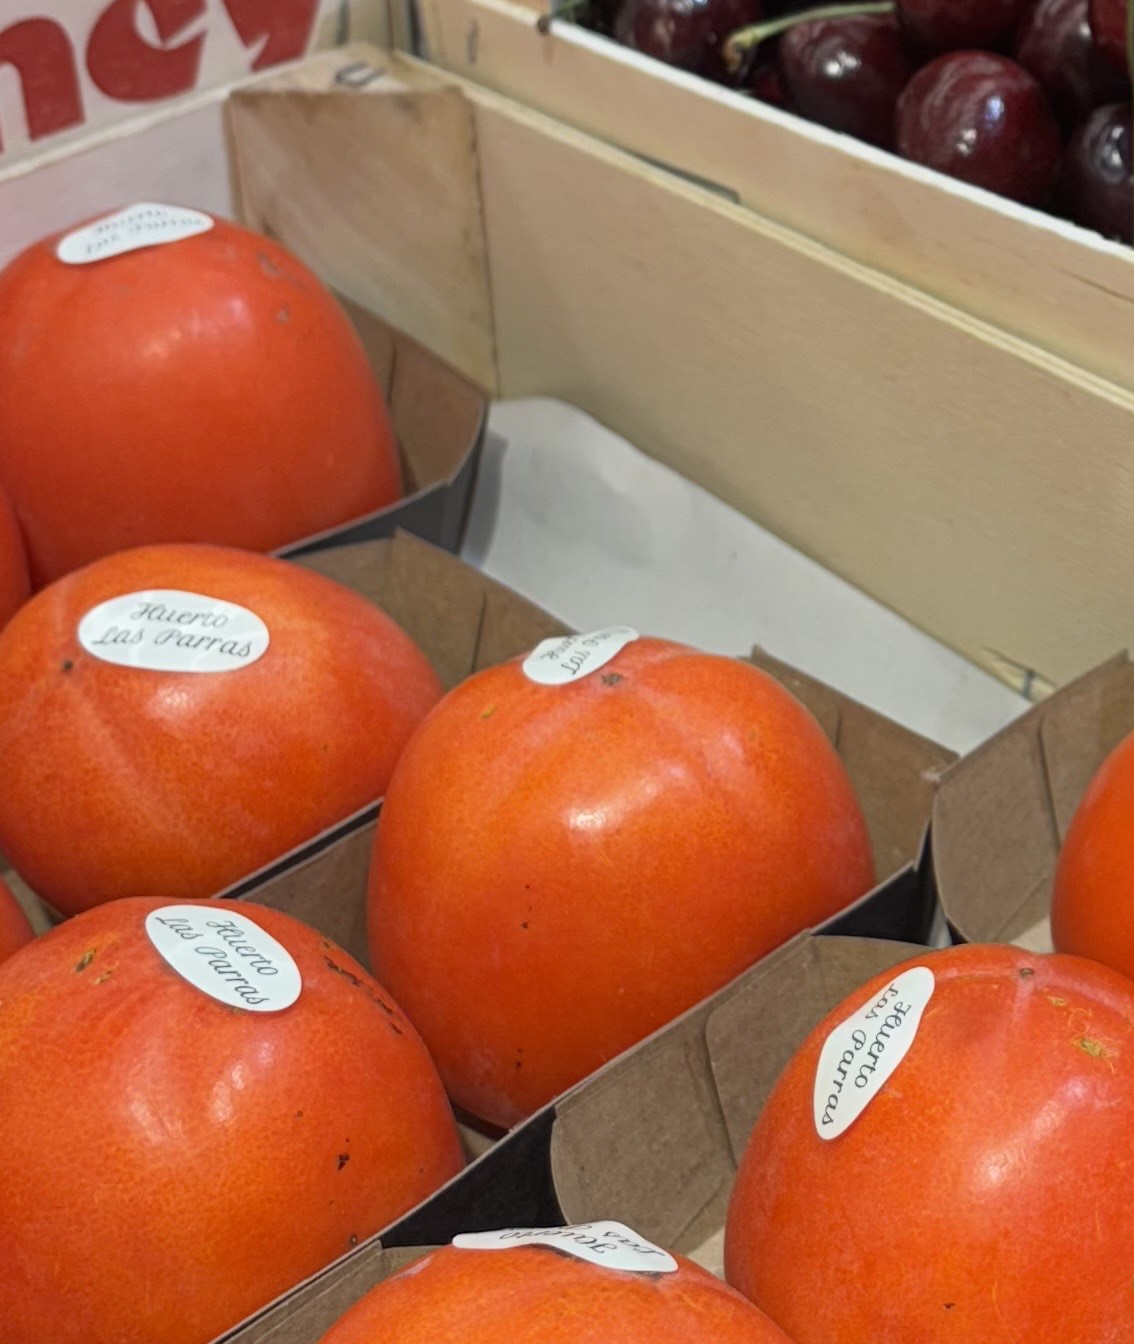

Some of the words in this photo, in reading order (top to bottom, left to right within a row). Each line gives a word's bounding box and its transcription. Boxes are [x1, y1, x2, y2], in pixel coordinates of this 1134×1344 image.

[131, 602, 229, 628] Huerto
[92, 626, 145, 645] Las
[154, 628, 253, 658] Parras
[155, 917, 204, 940] Las
[195, 946, 270, 1004] Parras
[206, 920, 278, 975] Huerto
[865, 982, 899, 1020] Las
[854, 1001, 911, 1088] Huerto
[821, 1029, 866, 1126] Parras
[602, 1231, 666, 1257] Las
